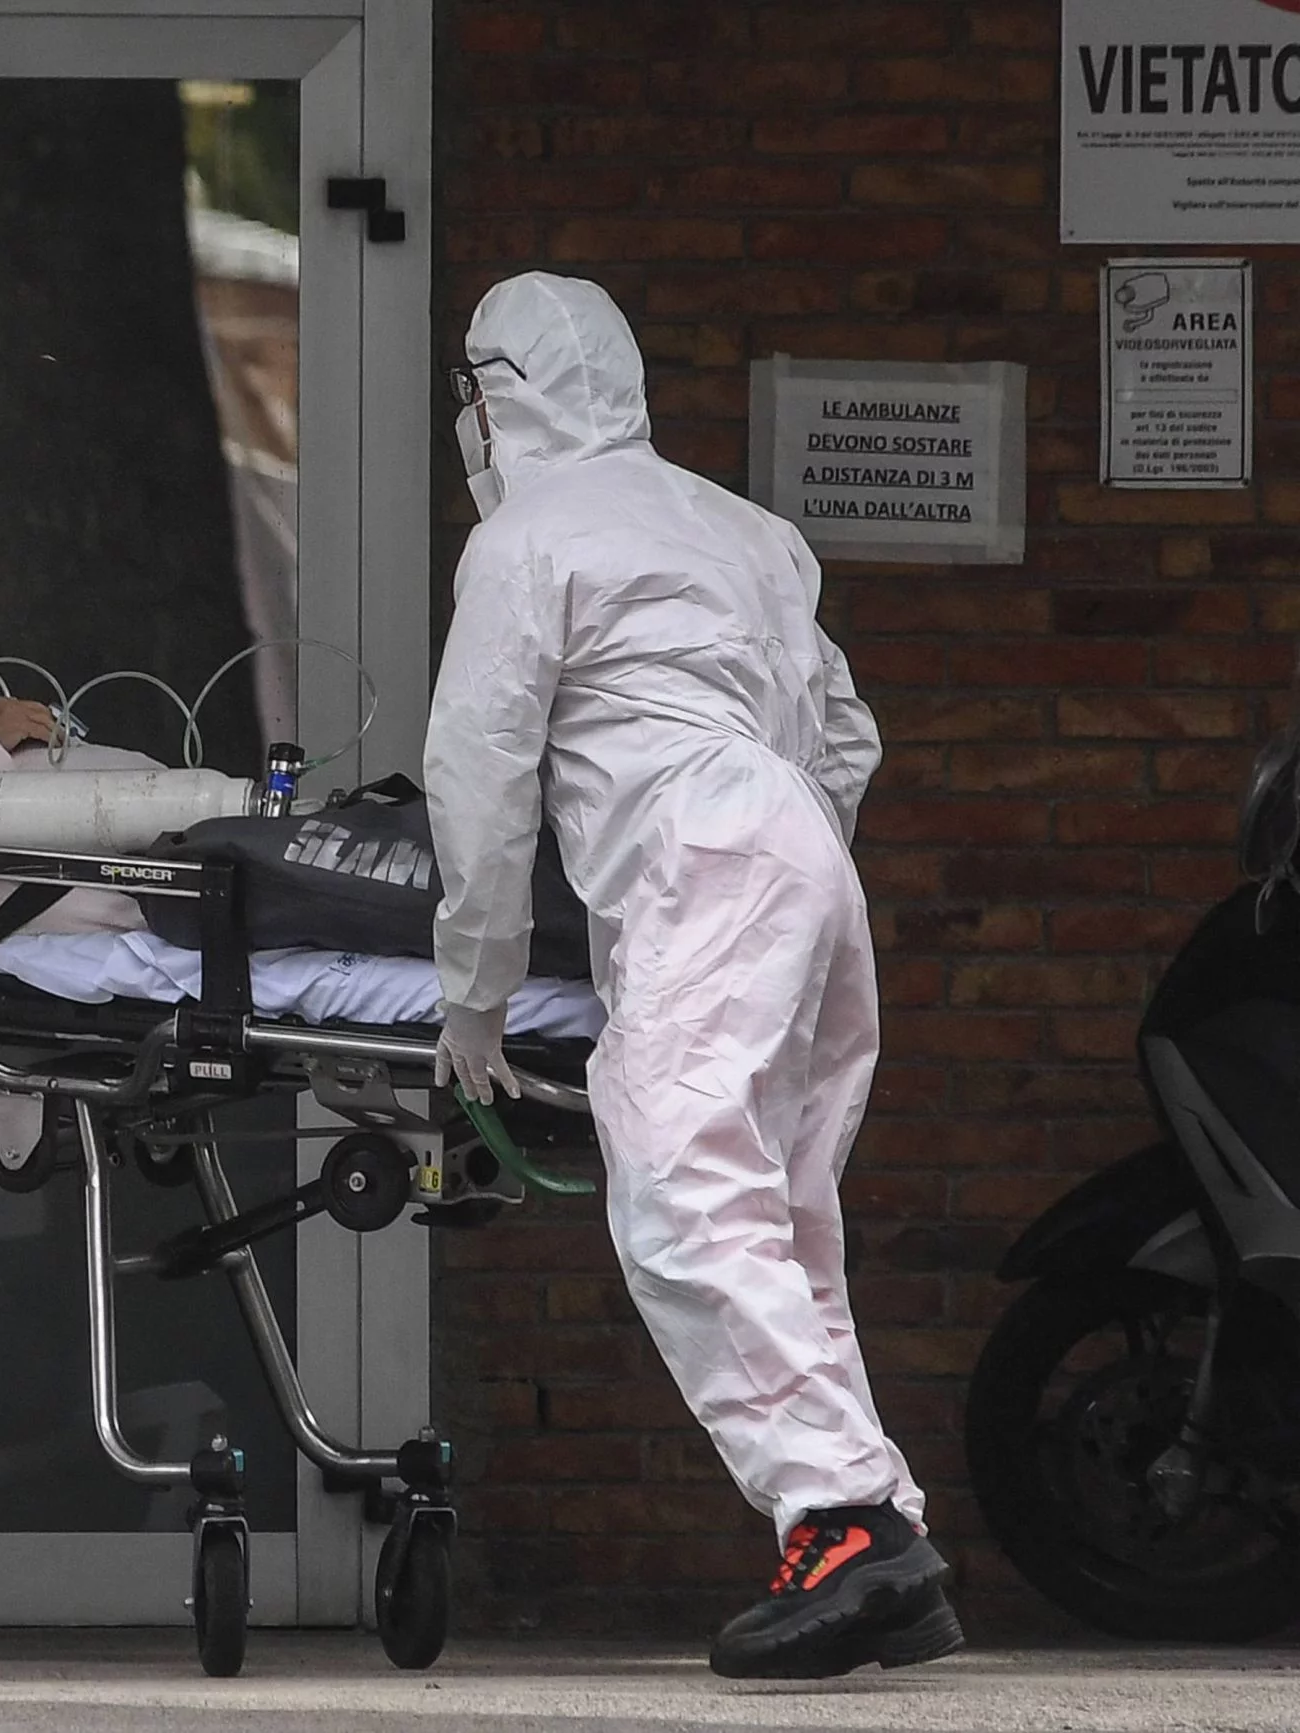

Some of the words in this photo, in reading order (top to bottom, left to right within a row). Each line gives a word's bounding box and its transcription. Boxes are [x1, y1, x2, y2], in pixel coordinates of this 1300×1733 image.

[1078, 44, 1300, 114] VIETATO
[1172, 312, 1237, 331] AREA
[1115, 339, 1237, 350] VIDEOSORVEGLIATA
[822, 401, 842, 419] LE
[847, 402, 961, 424] AMBULANZE
[807, 433, 888, 453] DEVONO
[892, 436, 972, 457] SOSTARE
[803, 466, 816, 484] A
[821, 467, 911, 486] DISTANZA
[916, 470, 935, 488] DI
[940, 471, 950, 489] 3
[956, 472, 973, 490] M
[803, 499, 859, 518] L'UNA
[864, 500, 972, 523] DALL'ALTRA
[100, 864, 172, 881] SPENCER
[195, 1065, 229, 1078] PULL
